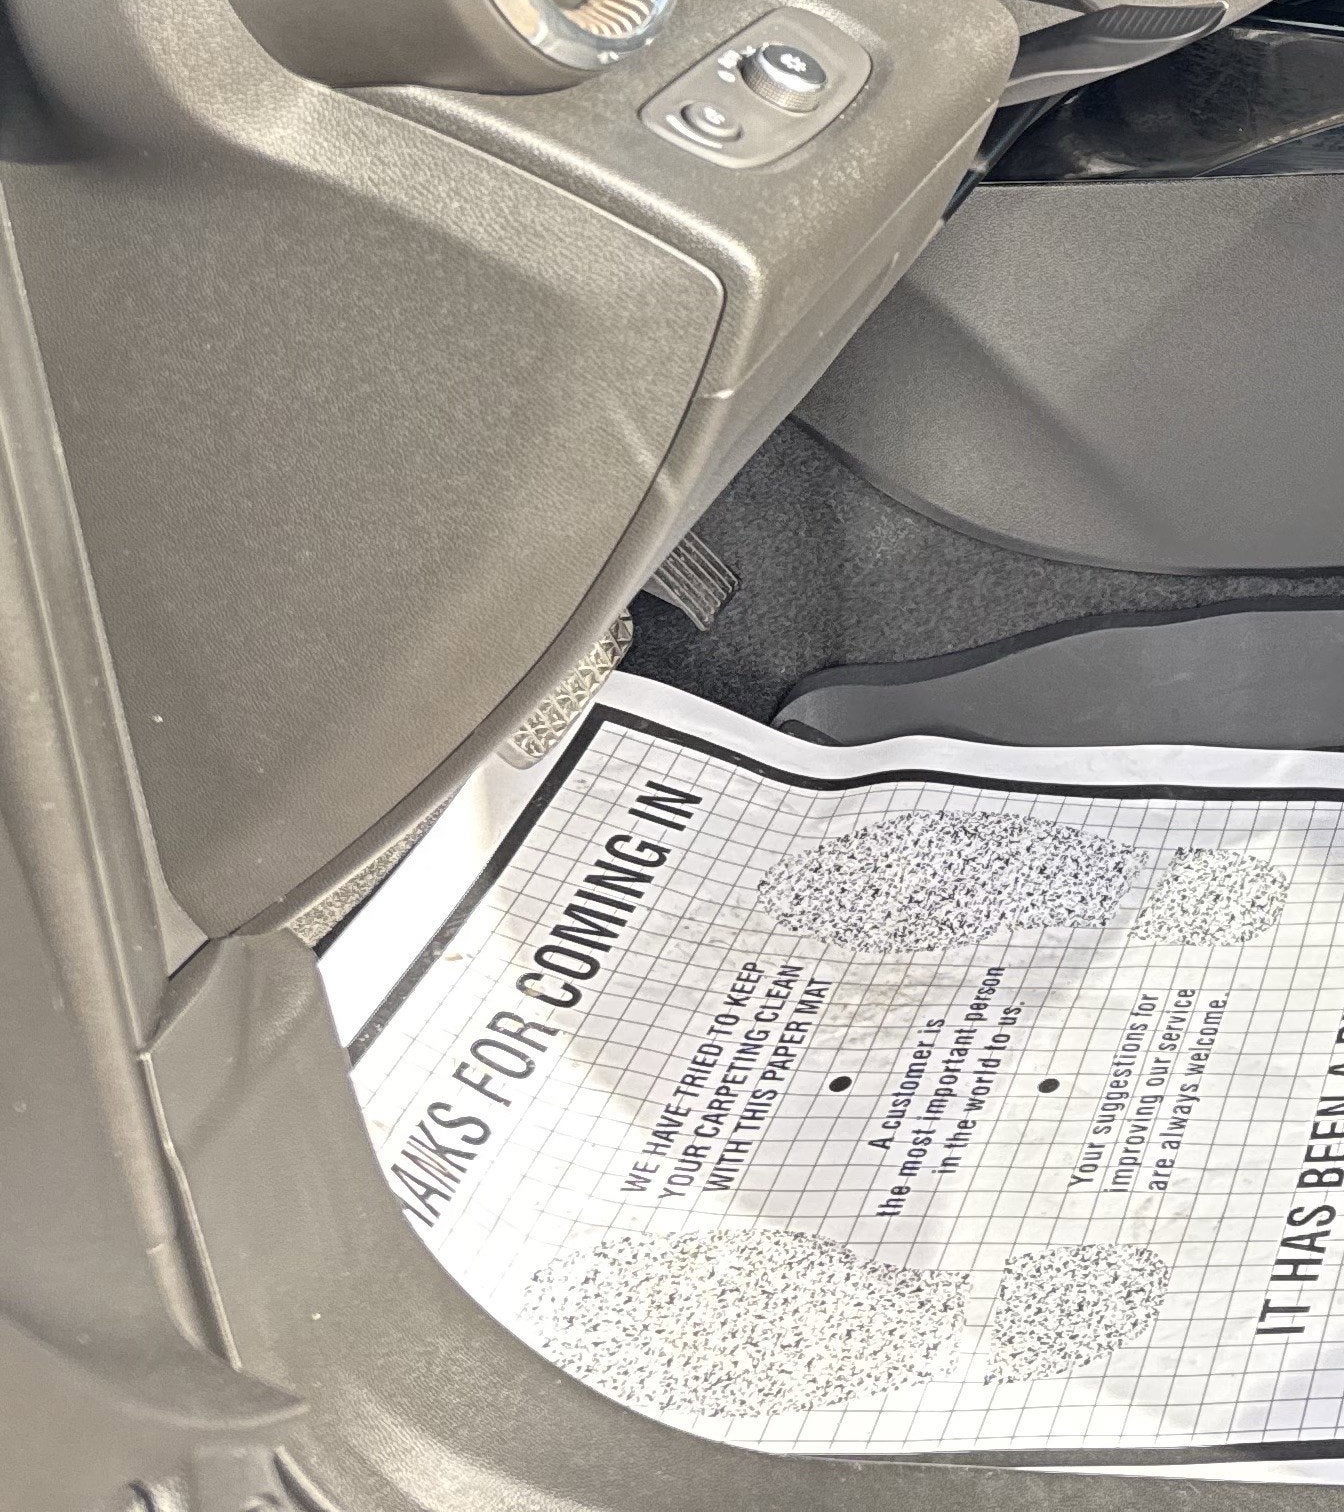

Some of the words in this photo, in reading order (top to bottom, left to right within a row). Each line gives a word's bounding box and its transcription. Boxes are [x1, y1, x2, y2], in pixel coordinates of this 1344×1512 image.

[452, 1010, 560, 1107] FOR
[516, 834, 671, 1008] COMING
[628, 780, 703, 832] IN
[964, 966, 1006, 1022] person
[998, 1001, 1026, 1027] us.
[1158, 988, 1196, 1051] service
[983, 1032, 1011, 1051] to
[1184, 991, 1231, 1077] welcome.
[620, 1161, 661, 1192] WE
[642, 1103, 692, 1156] HAVE
[673, 1043, 724, 1098] TRIED
[706, 1013, 740, 1036] TO
[723, 962, 765, 1007] KEEP
[657, 1143, 712, 1199] YOUR
[693, 1029, 771, 1138] CARPETING
[754, 964, 804, 1023] CLEAN
[702, 1140, 754, 1192] WITH
[732, 1088, 778, 1133] THIS
[760, 1020, 813, 1082] PAPER
[793, 977, 833, 1015] MAT
[868, 1136, 896, 1150] A
[882, 1040, 935, 1130] customer
[917, 1018, 946, 1034] is
[916, 1027, 978, 1121] important
[963, 1057, 1002, 1113] world
[1067, 1142, 1106, 1188] Your
[1092, 1022, 1149, 1135] suggestions
[1130, 993, 1159, 1017] for
[1145, 1056, 1172, 1087] our
[944, 1119, 977, 1149] the
[1102, 1094, 1165, 1193] improving
[1158, 1083, 1201, 1150] always
[898, 1126, 937, 1177] most
[931, 1156, 963, 1174] in
[1148, 1158, 1176, 1191] are
[876, 1184, 911, 1217] the
[1269, 1204, 1337, 1281] HAS
[1255, 1298, 1311, 1335] IT
